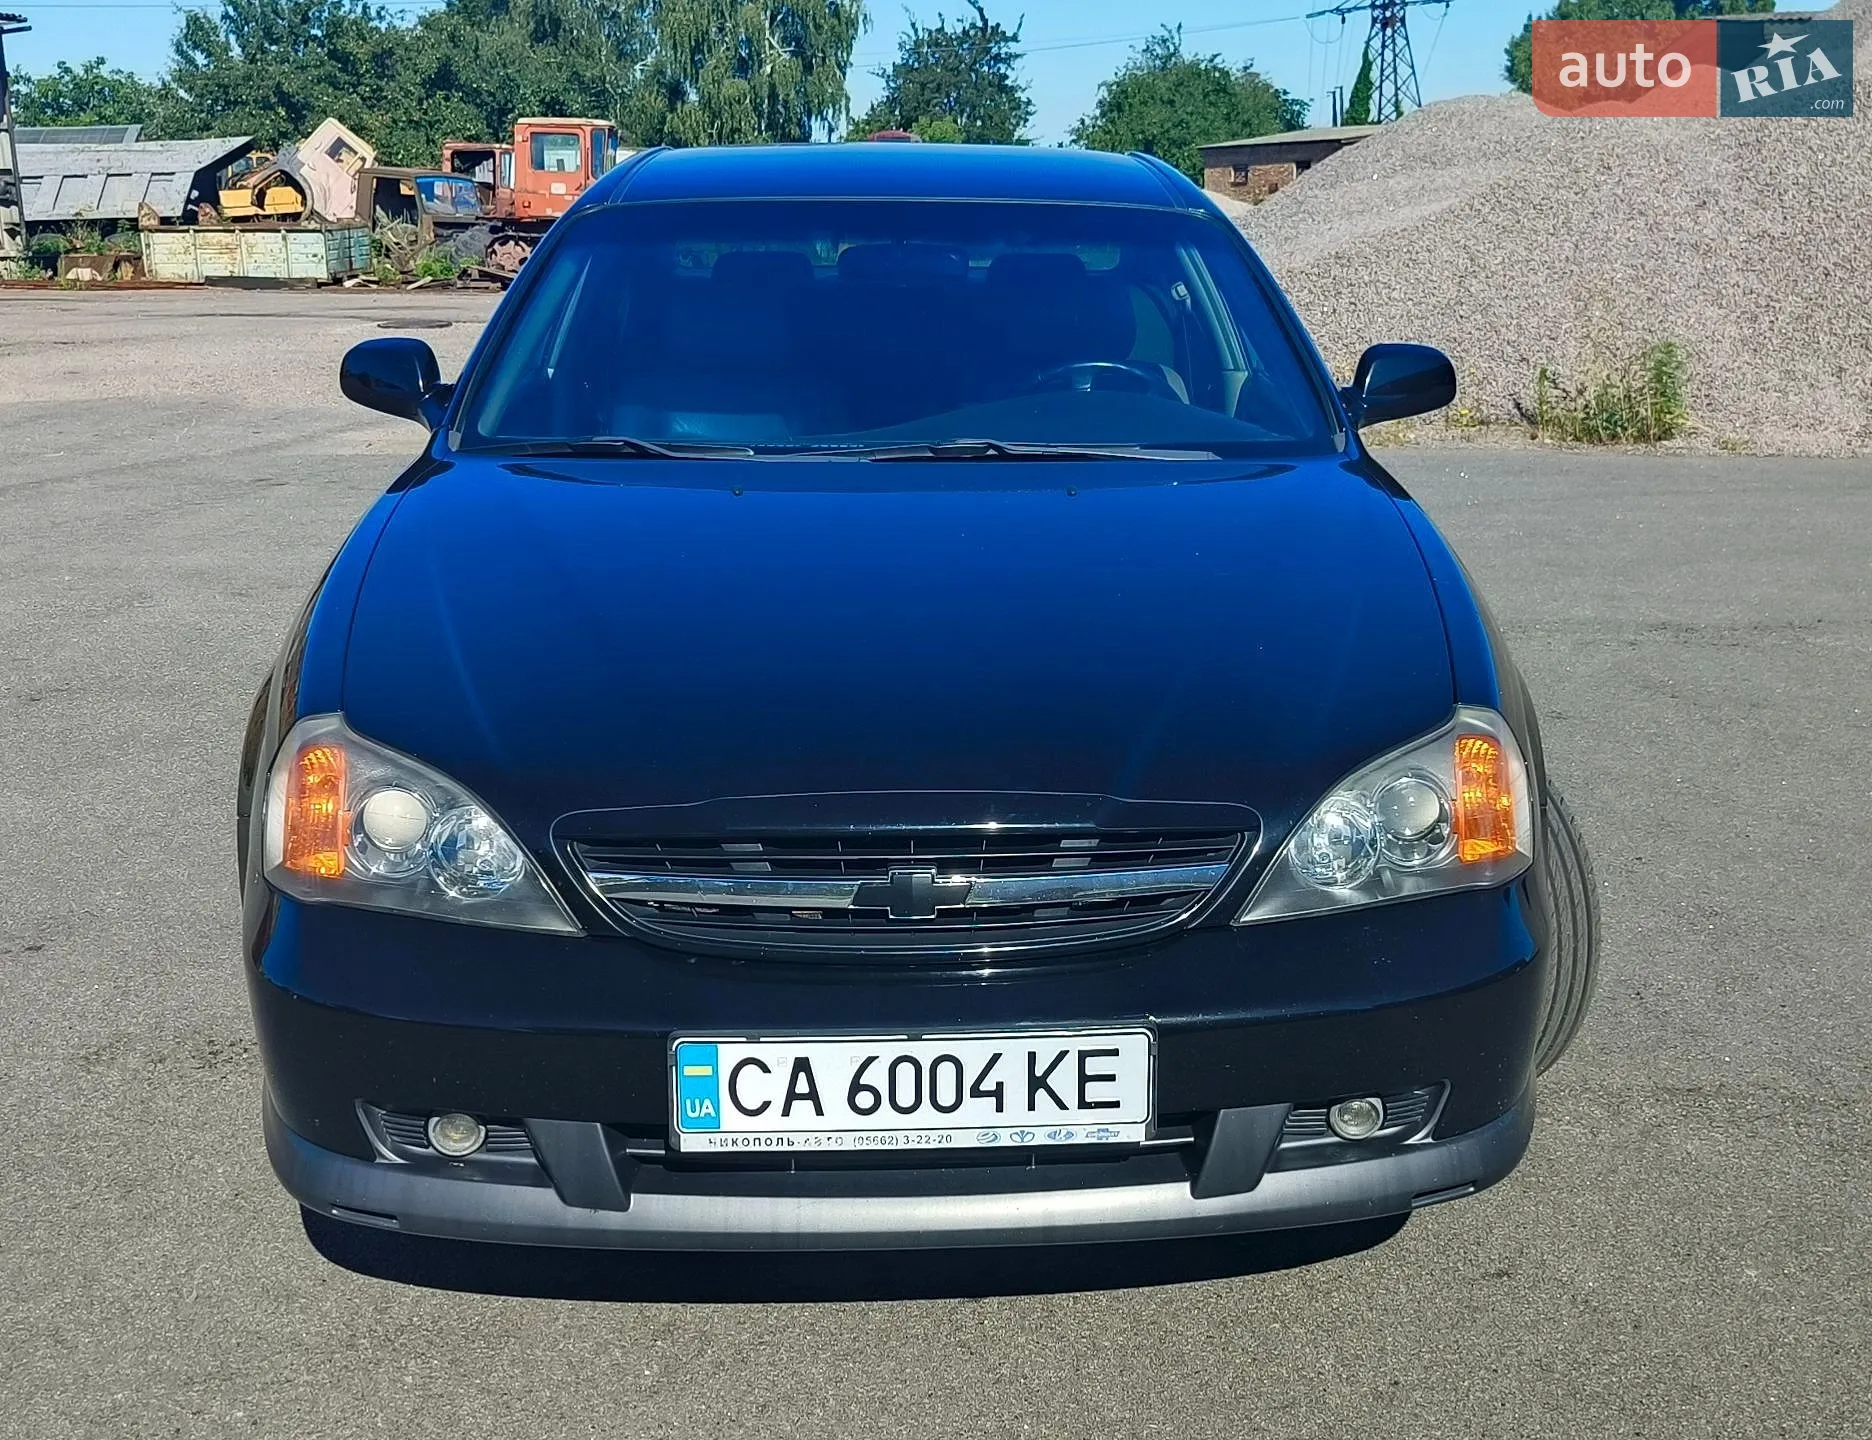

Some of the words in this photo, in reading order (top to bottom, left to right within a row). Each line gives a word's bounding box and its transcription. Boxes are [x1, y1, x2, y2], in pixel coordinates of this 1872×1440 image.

[728, 1056, 825, 1117] CA
[846, 1052, 1005, 1116] 6004
[1027, 1048, 1121, 1112] KE
[685, 1098, 716, 1118] UA
[903, 1133, 952, 1145] 3-22-20
